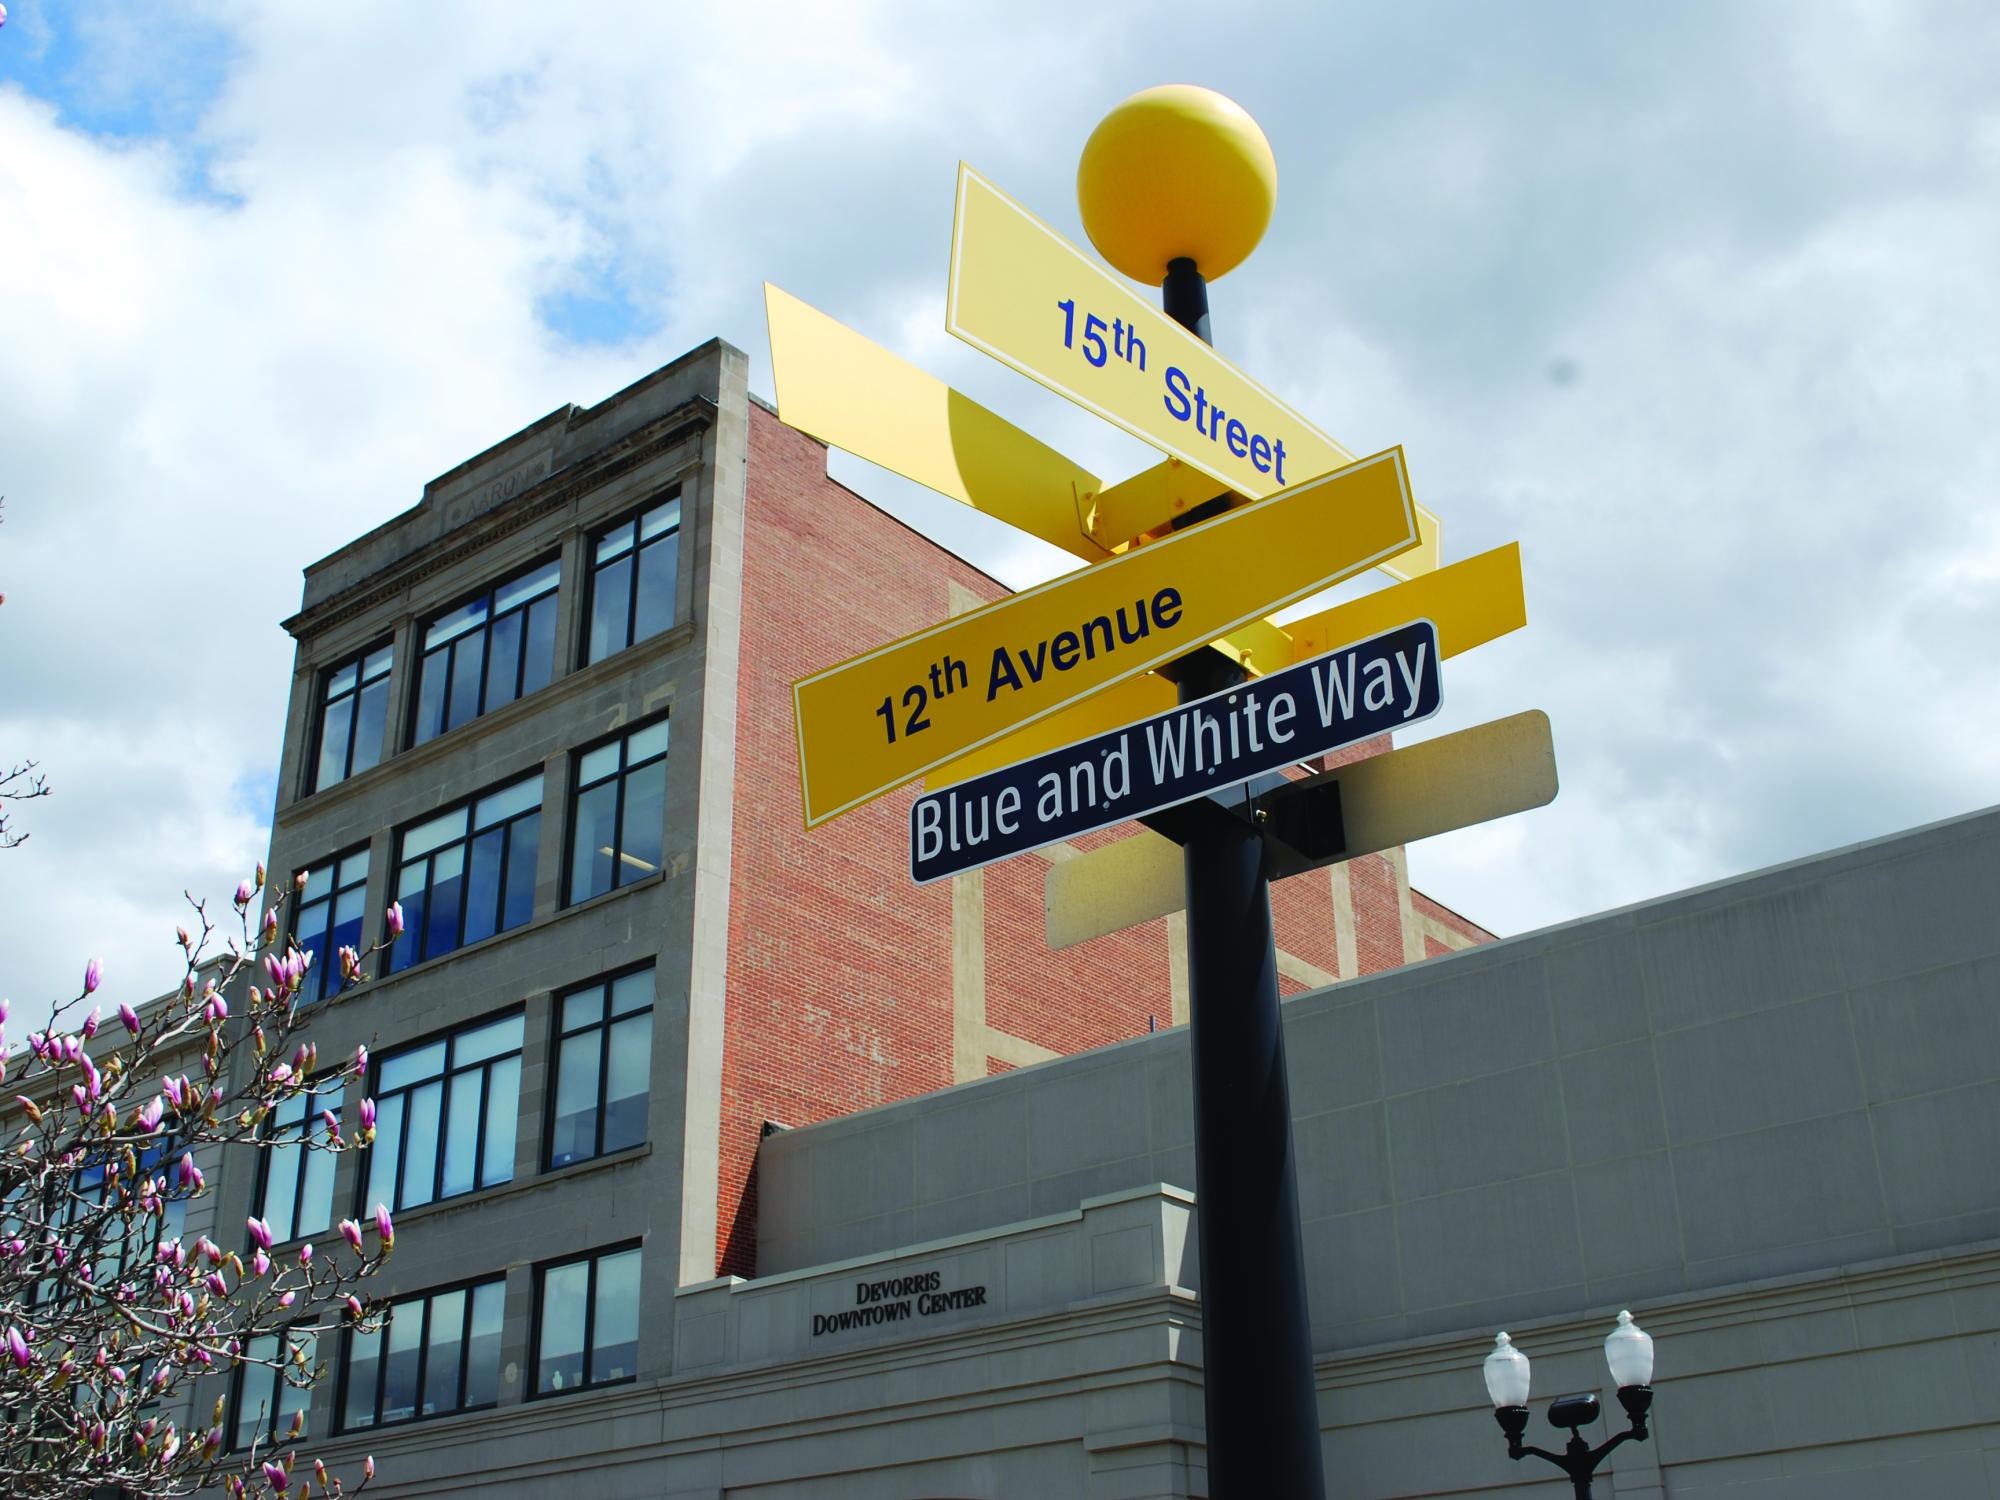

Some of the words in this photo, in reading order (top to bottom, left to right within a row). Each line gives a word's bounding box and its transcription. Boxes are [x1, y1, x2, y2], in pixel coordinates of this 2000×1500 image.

[1058, 299, 1146, 372] 15th
[1164, 366, 1286, 486] Street
[876, 655, 969, 745] 12th
[987, 587, 1183, 702] Avenue
[916, 786, 1021, 863] Blue
[1036, 735, 1130, 823] and
[1145, 691, 1296, 786] White
[1312, 642, 1427, 728] Way
